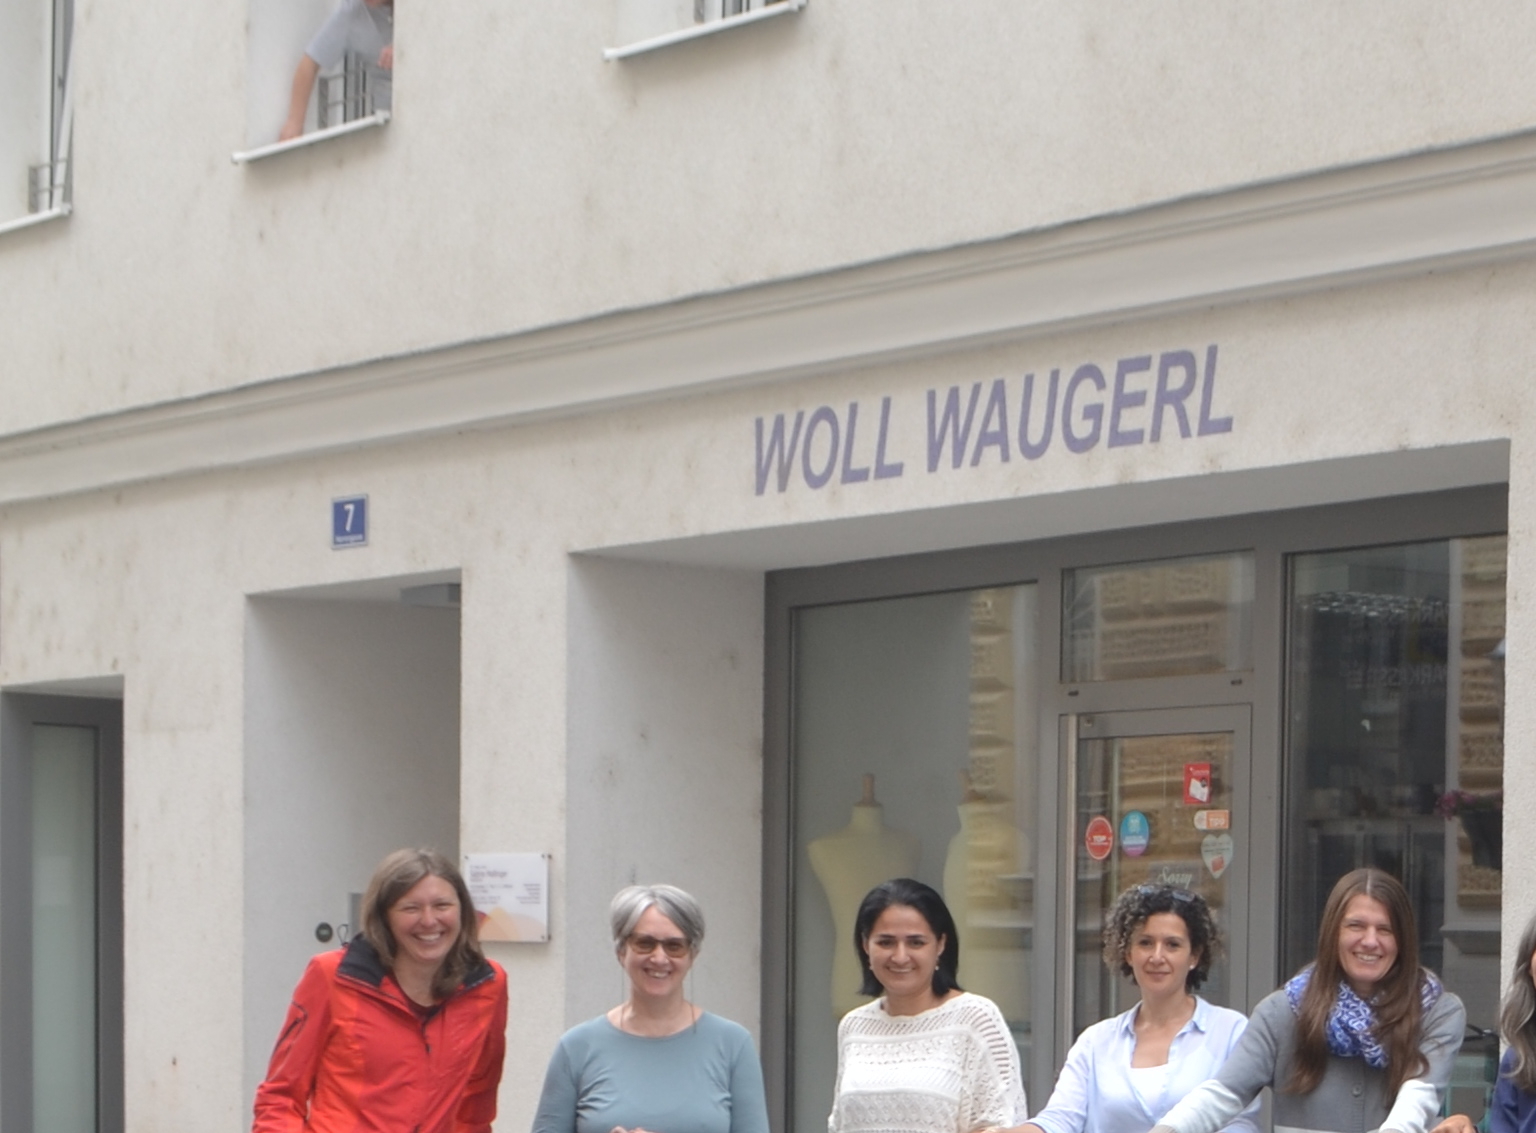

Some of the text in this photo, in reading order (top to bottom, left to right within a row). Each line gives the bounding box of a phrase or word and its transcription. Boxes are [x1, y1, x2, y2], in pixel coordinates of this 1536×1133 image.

[755, 344, 1233, 496] WOLL WAUGERL
[344, 503, 354, 532] 7
